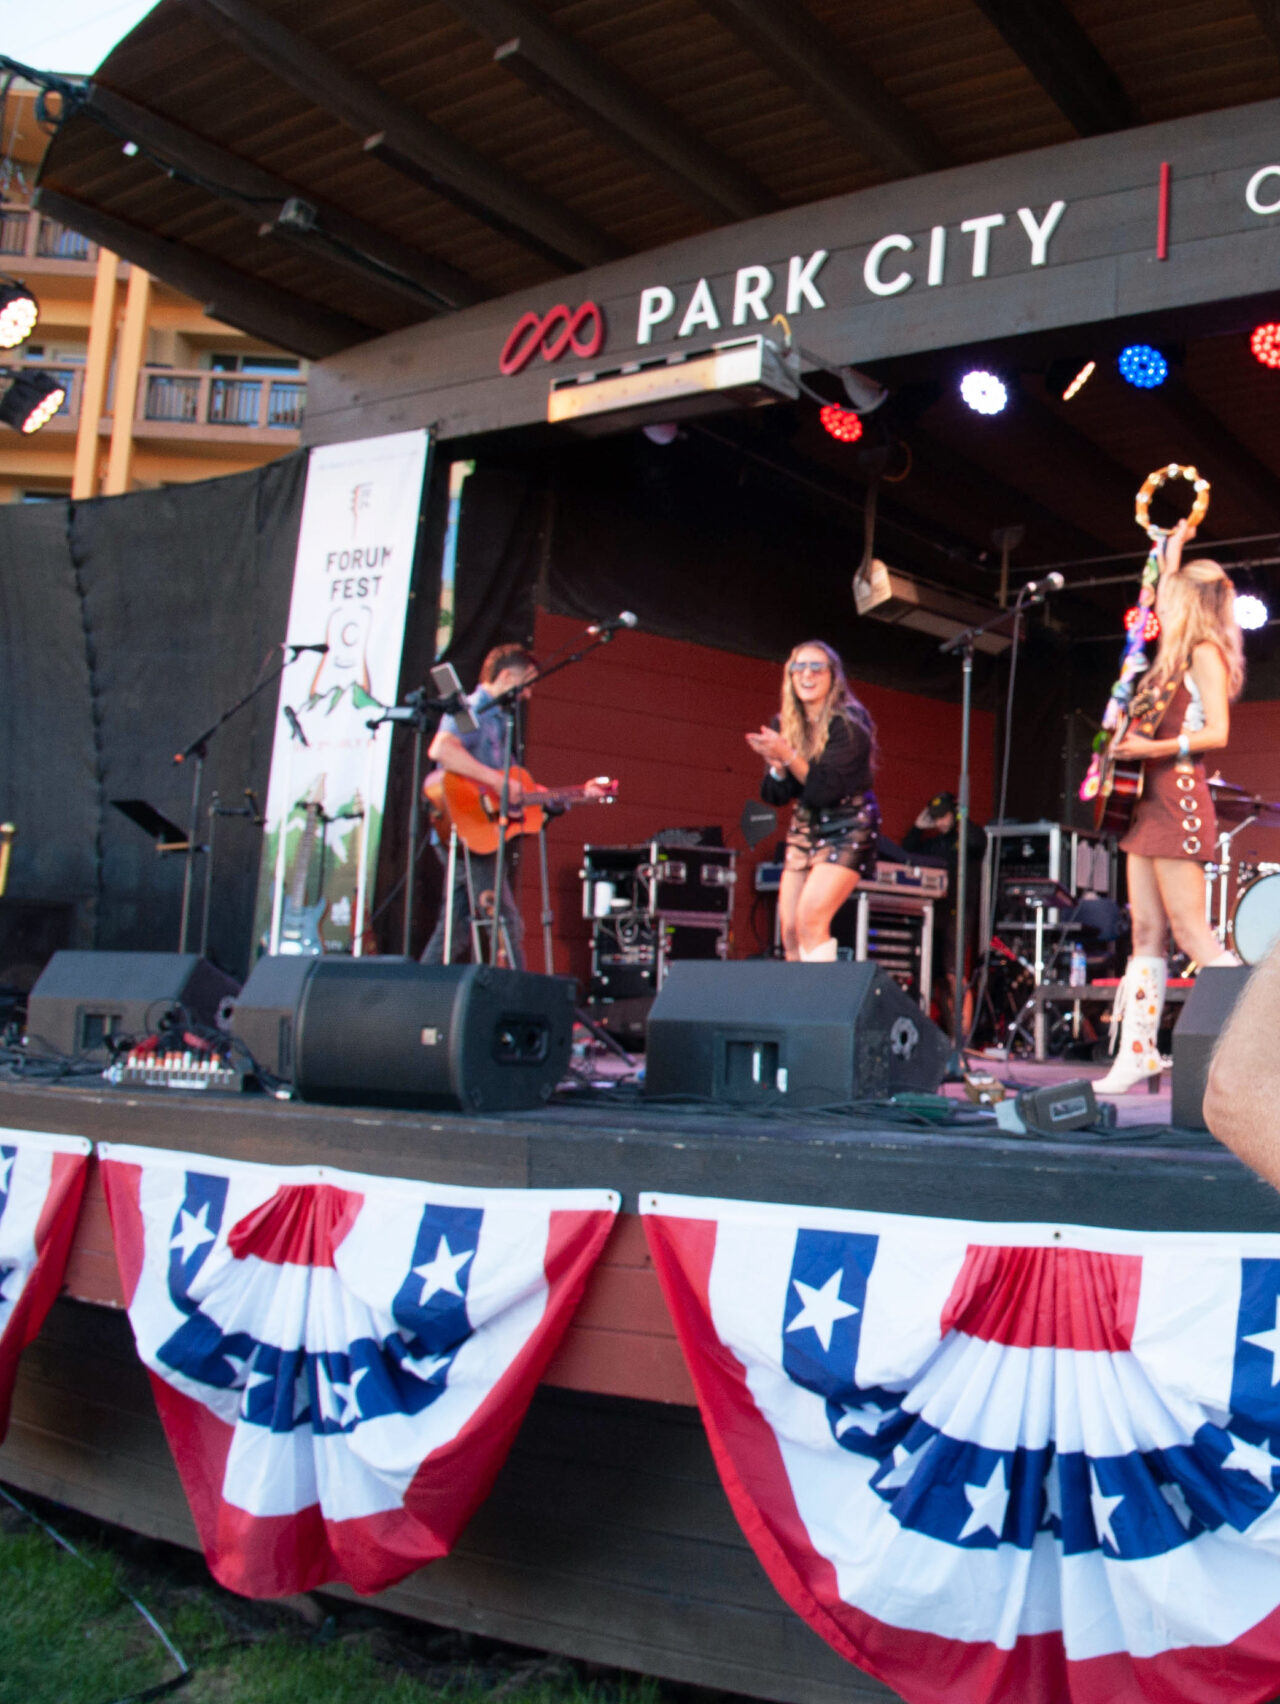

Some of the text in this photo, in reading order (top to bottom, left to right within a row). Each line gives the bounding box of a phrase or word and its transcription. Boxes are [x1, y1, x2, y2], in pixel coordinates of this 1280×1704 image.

[637, 200, 1067, 345] PARK CITY
[331, 576, 383, 600] FEST
